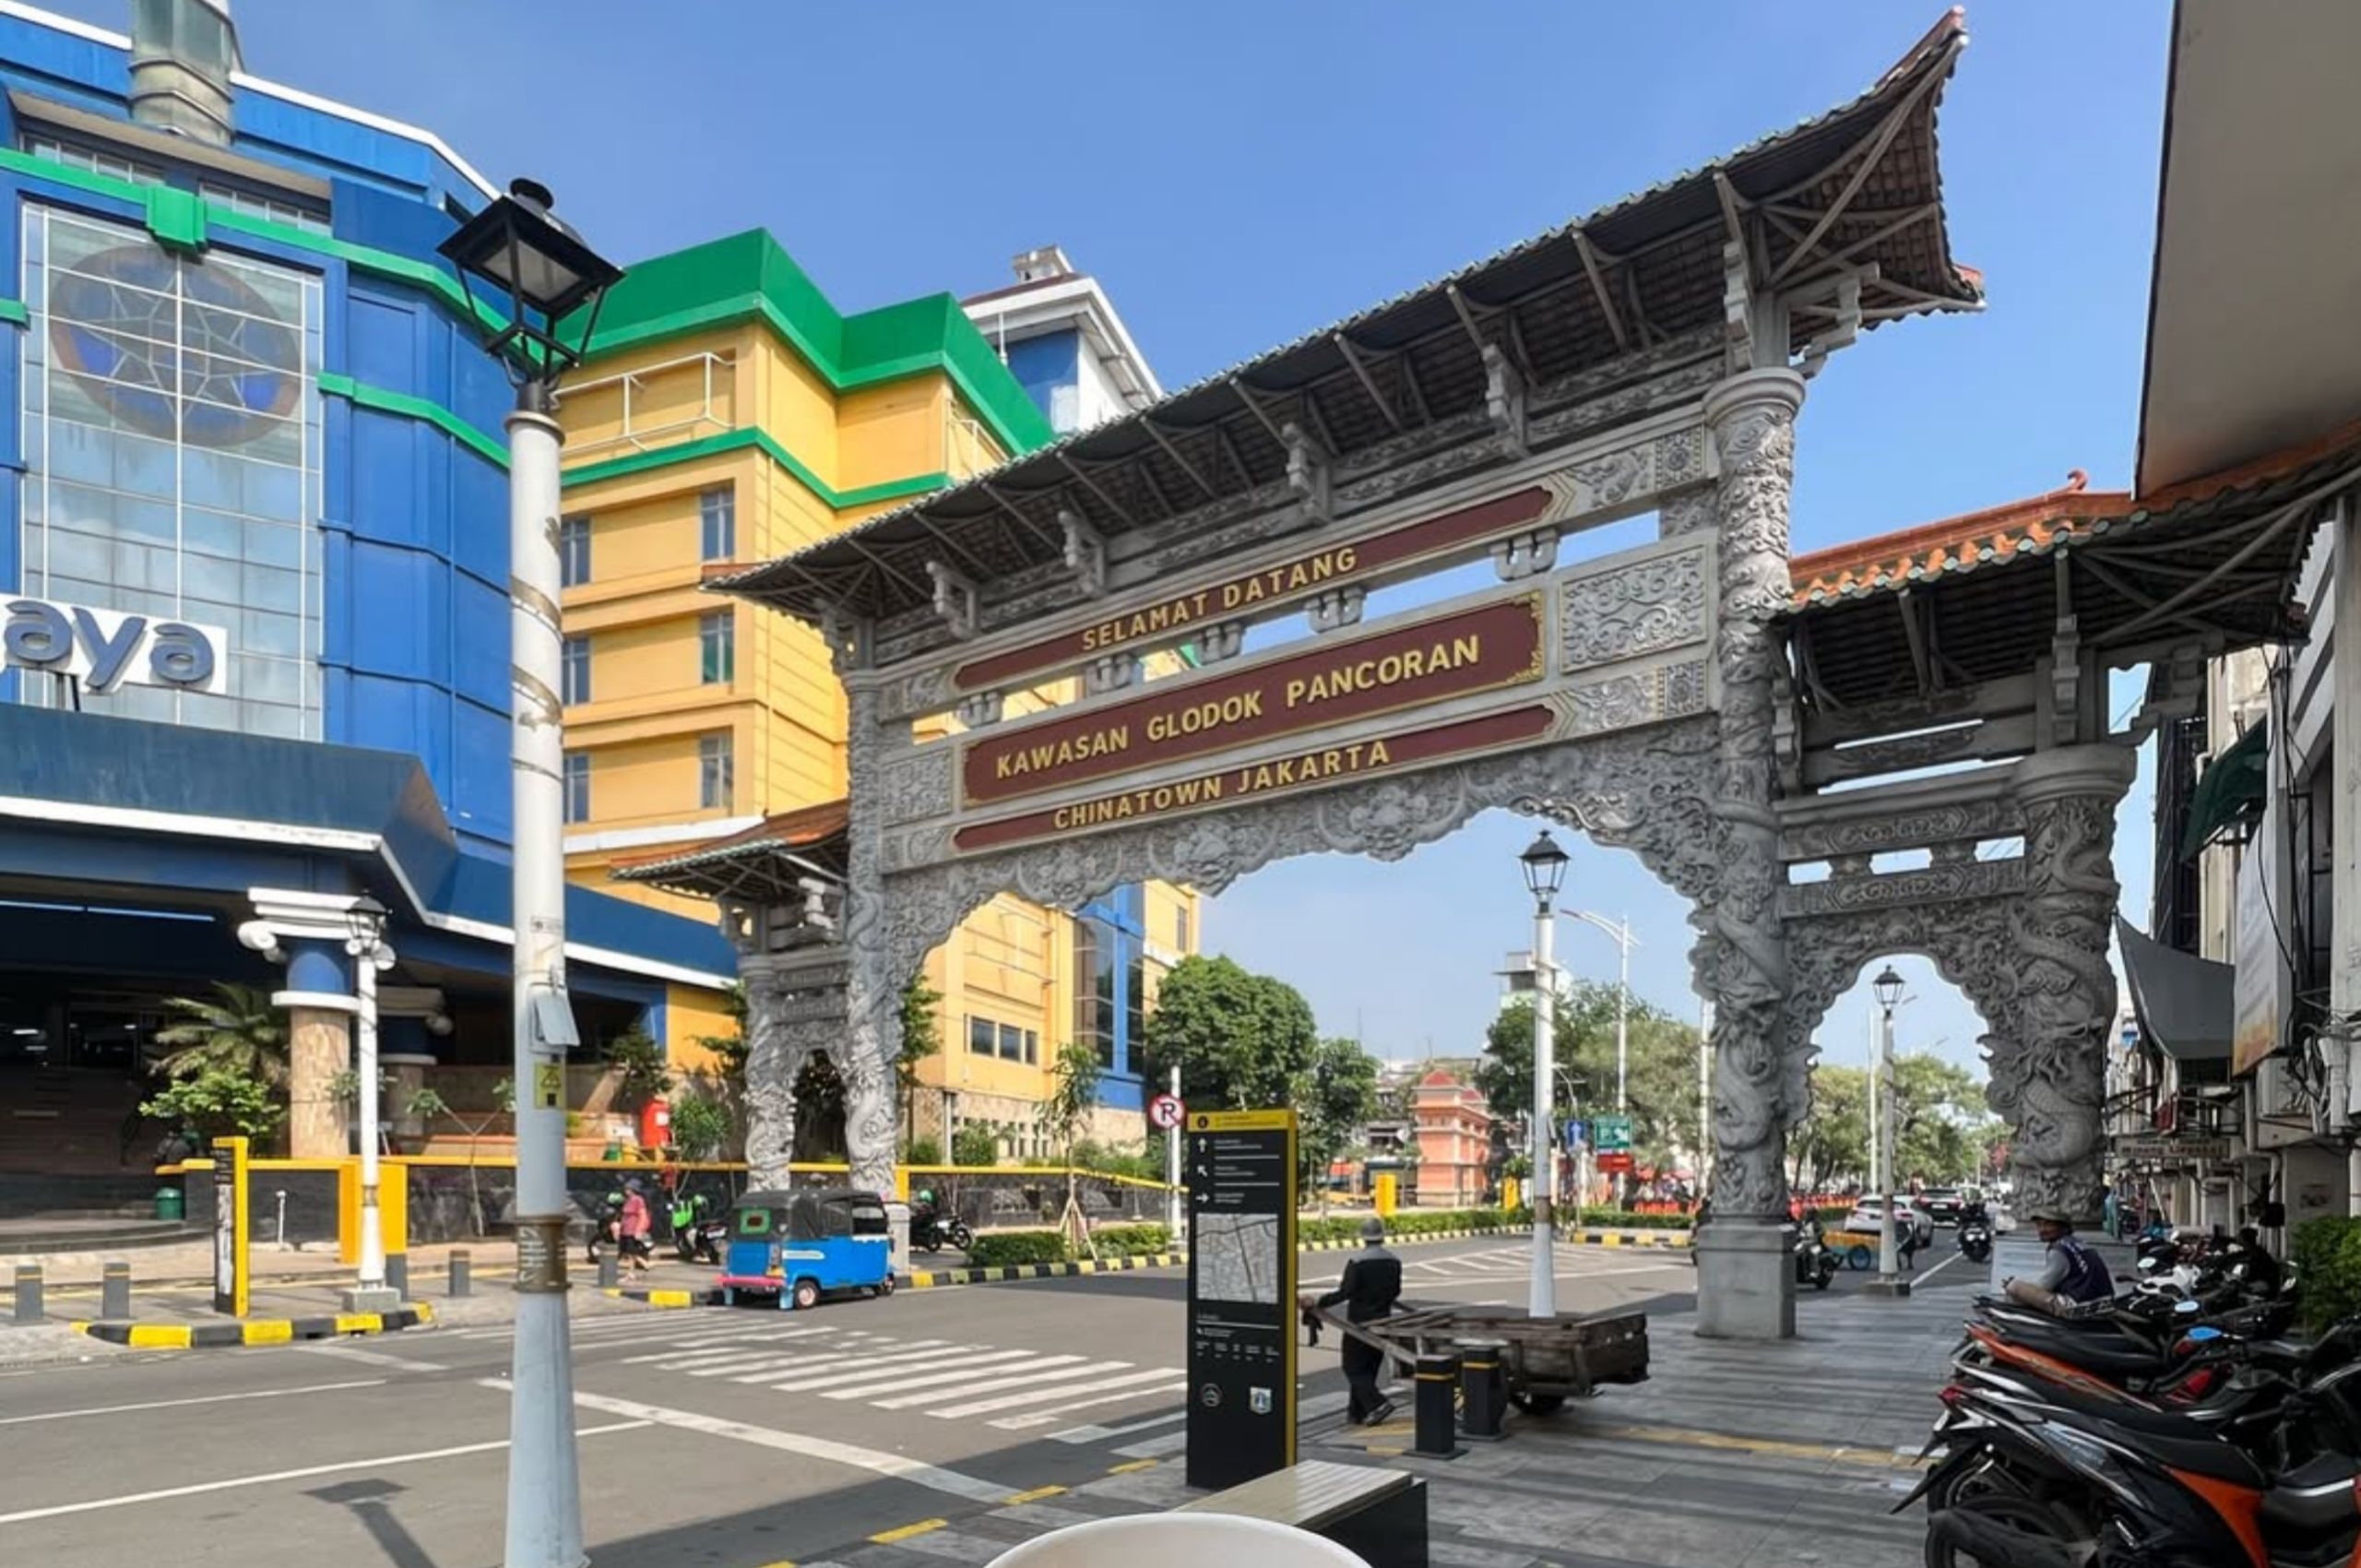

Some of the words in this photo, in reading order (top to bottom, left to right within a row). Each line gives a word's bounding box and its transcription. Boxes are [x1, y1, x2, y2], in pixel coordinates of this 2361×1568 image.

[1082, 592, 1209, 650] SELAMAT
[1222, 547, 1357, 608] DATANG
[996, 726, 1128, 778] KAWASAN
[1147, 690, 1262, 741] GLODOK
[1287, 635, 1479, 707] PANCORAN
[1054, 776, 1221, 829] CHINATOWN
[1238, 741, 1390, 793] JAKARTA
